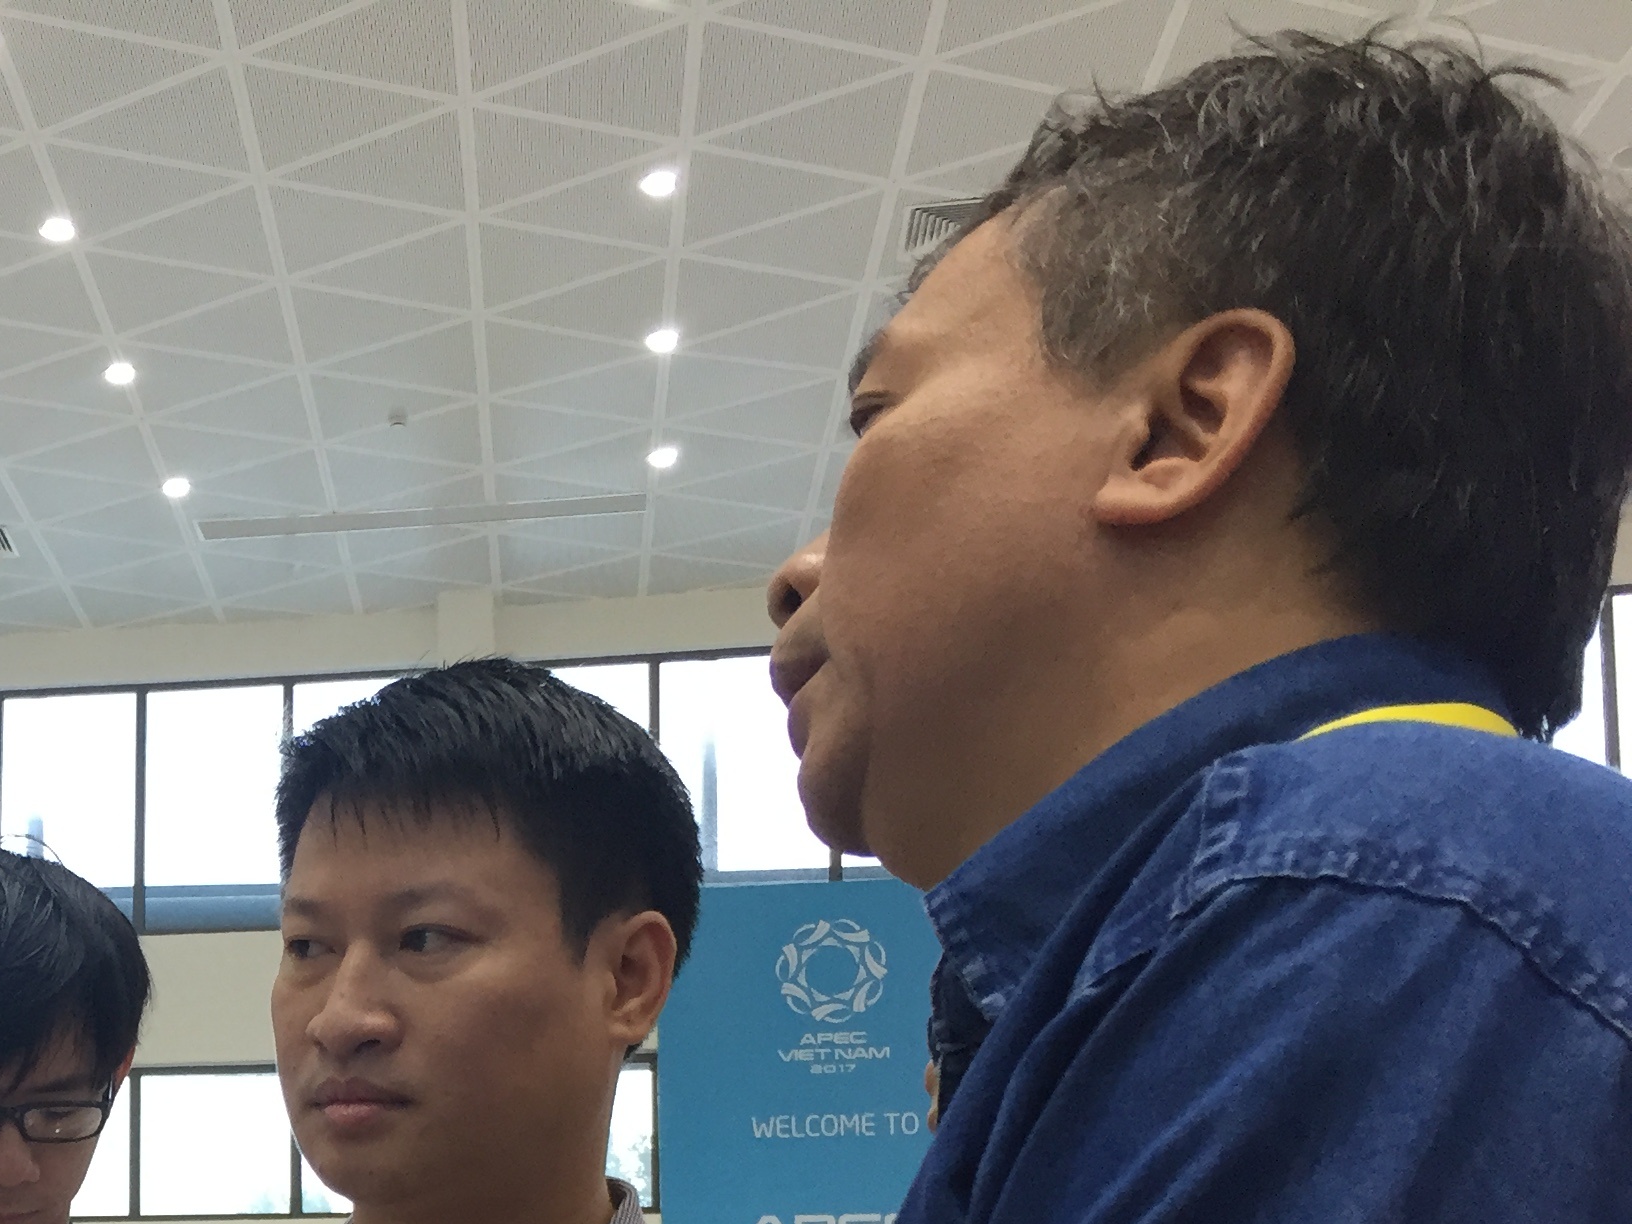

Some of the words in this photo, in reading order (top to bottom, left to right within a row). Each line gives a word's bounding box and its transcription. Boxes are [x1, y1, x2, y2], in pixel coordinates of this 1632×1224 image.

[800, 1031, 867, 1045] APEC
[777, 1048, 832, 1062] VIET
[835, 1046, 890, 1060] NAM
[810, 1064, 856, 1074] 2017
[751, 1113, 876, 1139] WELCOME
[884, 1112, 920, 1135] TO
